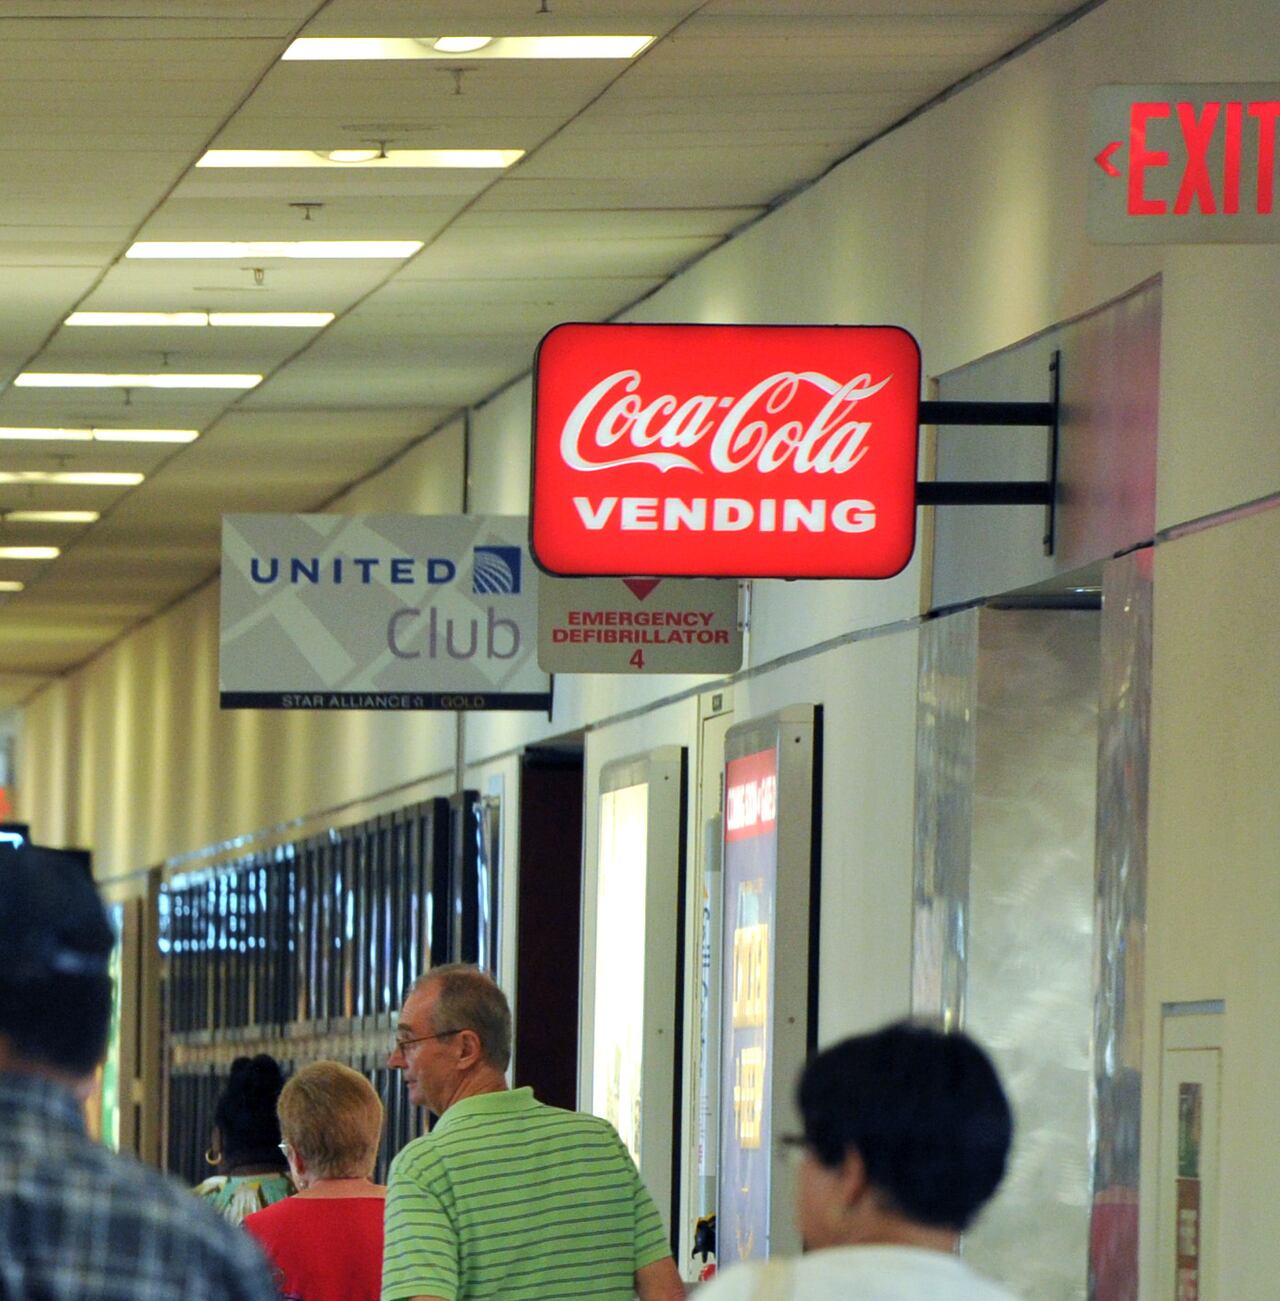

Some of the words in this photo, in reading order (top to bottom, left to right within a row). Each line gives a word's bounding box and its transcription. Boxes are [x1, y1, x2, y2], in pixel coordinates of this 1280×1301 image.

[1128, 102, 1280, 216] EXIT
[560, 369, 894, 475] Coca-Cola
[572, 496, 877, 533] VENDING
[250, 558, 457, 584] UNITED
[568, 611, 715, 626] EMERGENCY
[387, 606, 521, 660] Club
[552, 629, 729, 644] DEFIBRILLATOR
[629, 648, 645, 669] 4
[282, 694, 324, 708] STAR
[328, 694, 412, 708] ALLIANCE
[440, 694, 486, 708] GOLD
